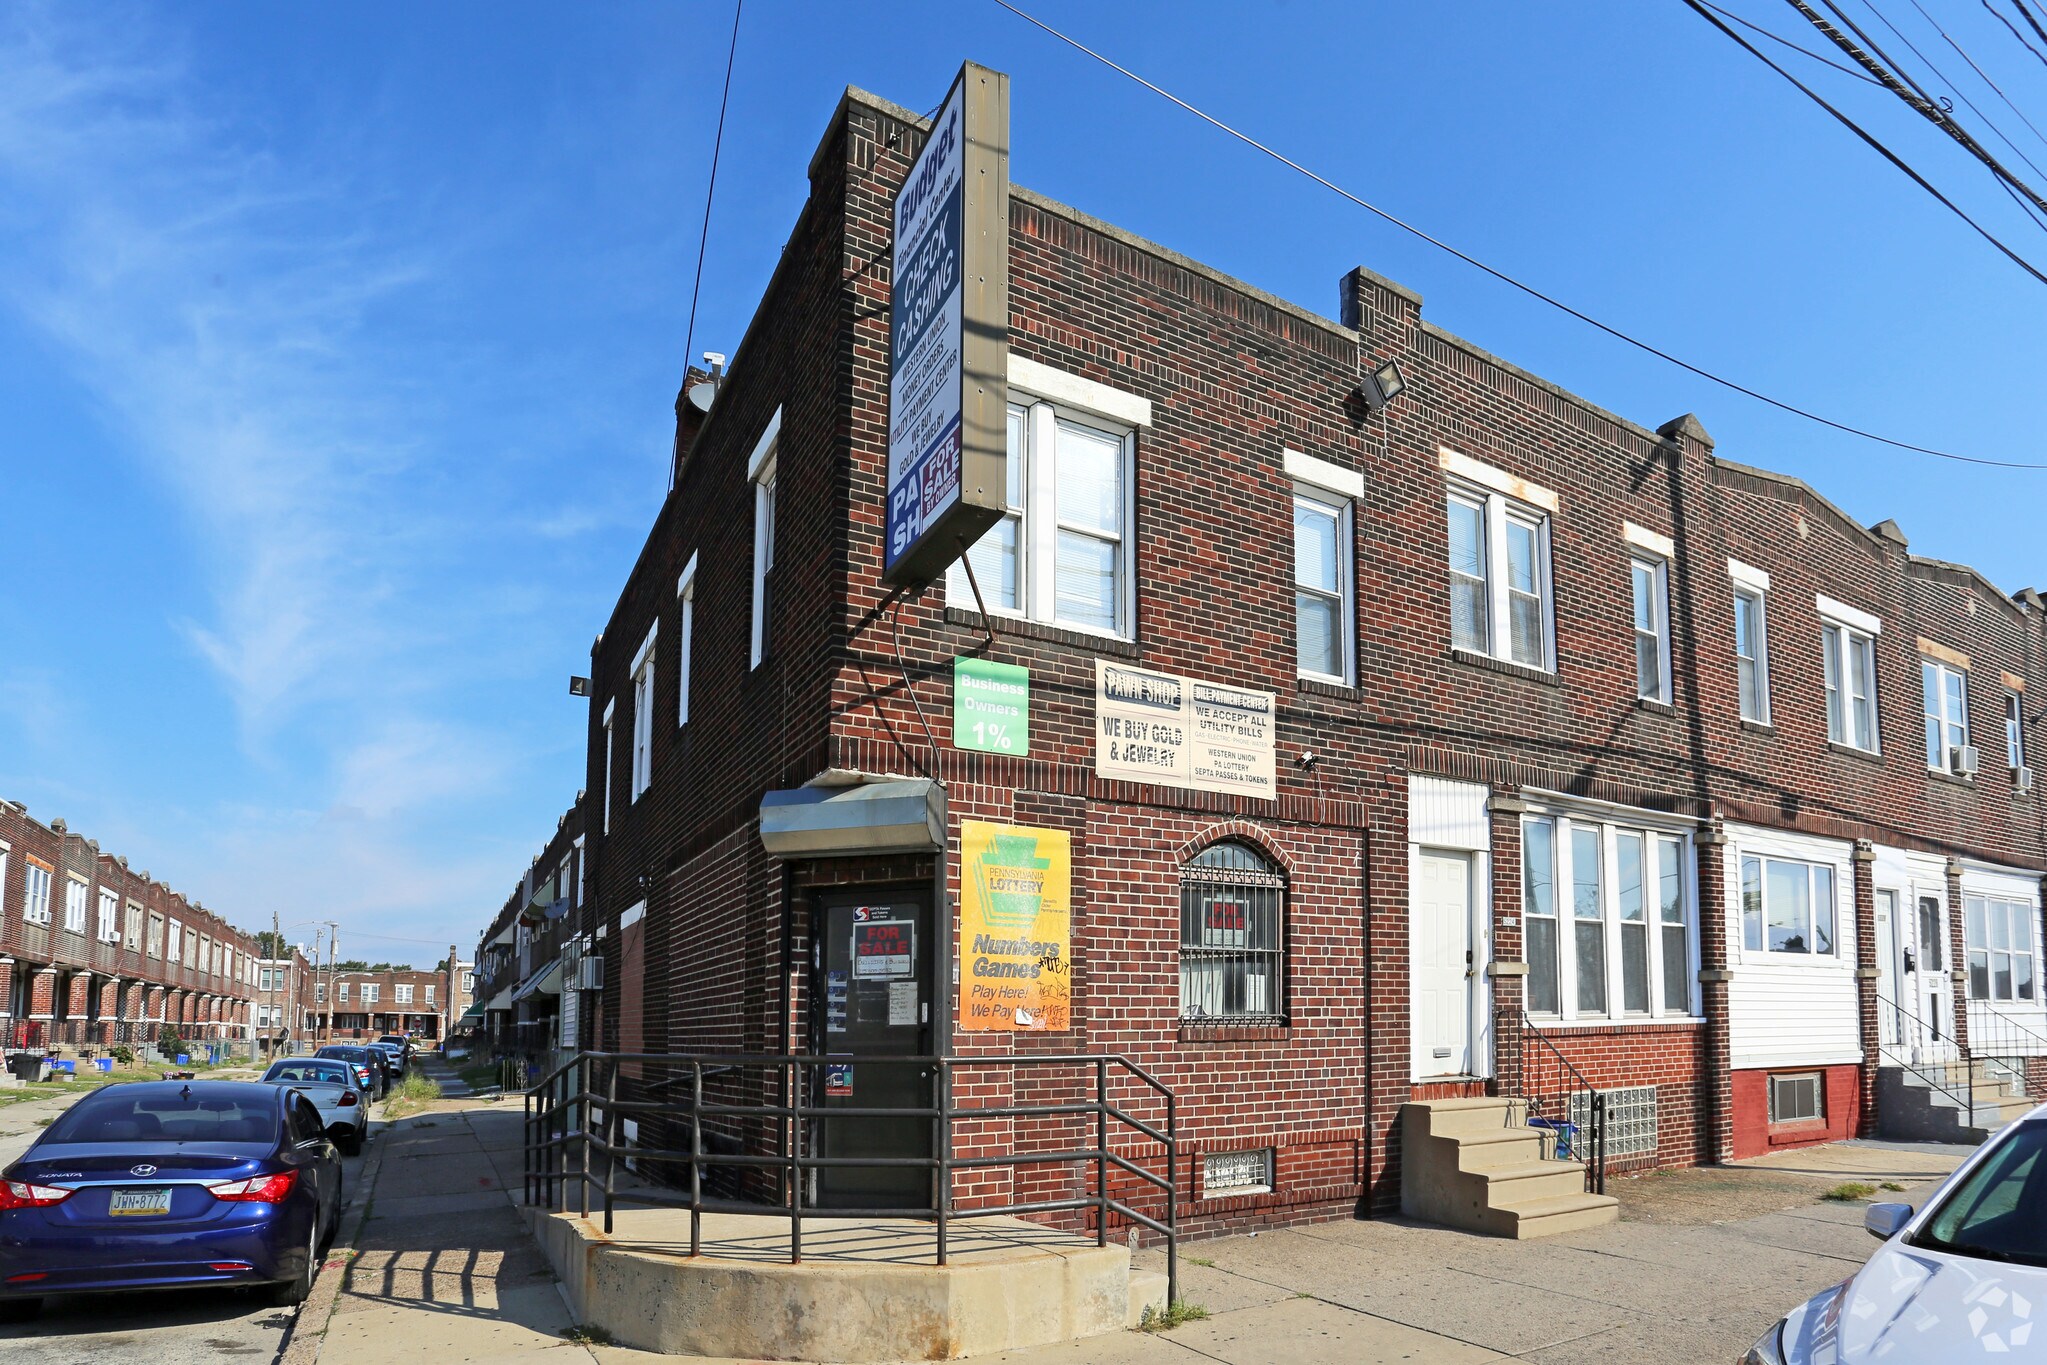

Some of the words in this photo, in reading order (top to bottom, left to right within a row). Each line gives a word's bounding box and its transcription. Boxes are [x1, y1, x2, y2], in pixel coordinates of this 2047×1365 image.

[899, 106, 957, 240] Budget
[897, 206, 928, 275] Financial
[929, 166, 955, 218] Center
[904, 210, 949, 308] CHECK
[897, 249, 953, 358] CASHING
[902, 338, 926, 381] WESTERN
[927, 310, 946, 346] UNION
[902, 372, 922, 406] MONEY
[922, 338, 944, 375] ORDERS
[890, 412, 909, 446] UTILITY
[909, 379, 935, 424] PAYMENT
[935, 349, 957, 390] CENTER
[911, 424, 921, 444] WE
[920, 408, 932, 432] BUY
[899, 453, 914, 475] GOLD
[919, 410, 945, 452] JEWELRY
[929, 436, 954, 478] FOR
[924, 447, 959, 502] SALE
[893, 474, 919, 523] PA
[926, 497, 934, 513] BY
[935, 473, 956, 502] OWNER
[893, 504, 920, 556] SH
[961, 674, 1025, 695] Business
[1105, 671, 1143, 699] PAWN
[1146, 679, 1178, 705] SHOP
[964, 697, 1019, 716] Owners
[1195, 706, 1210, 717] WE
[1213, 709, 1248, 723] ACCEPT
[1250, 716, 1267, 727] ALL
[972, 721, 1011, 749] 1%
[1103, 716, 1121, 737] WE
[1124, 720, 1148, 740] BUY
[1152, 723, 1182, 745] GOLD
[1200, 720, 1235, 734] UTILITY
[1238, 726, 1263, 738] BILLS
[1110, 741, 1119, 760] &
[1122, 743, 1175, 767] JEWELRY
[1208, 748, 1236, 759] WESTERN
[1237, 753, 1256, 762] UNION
[1214, 760, 1222, 768] PA
[1223, 761, 1249, 772] LOTTERY
[1194, 767, 1214, 776] SEPTA
[1215, 770, 1238, 780] PASSES
[1245, 774, 1268, 784] TOKENS
[989, 867, 1044, 880] PENNSYLVANIA
[990, 877, 1044, 893] LOTTERY
[866, 926, 899, 940] FOR
[972, 933, 1060, 956] Numbers
[859, 940, 908, 955] SALE
[972, 956, 1041, 978] Games
[971, 984, 997, 1001] Play
[998, 985, 1029, 998] Here!
[971, 1003, 990, 1016] We
[991, 1003, 1014, 1020] Pay
